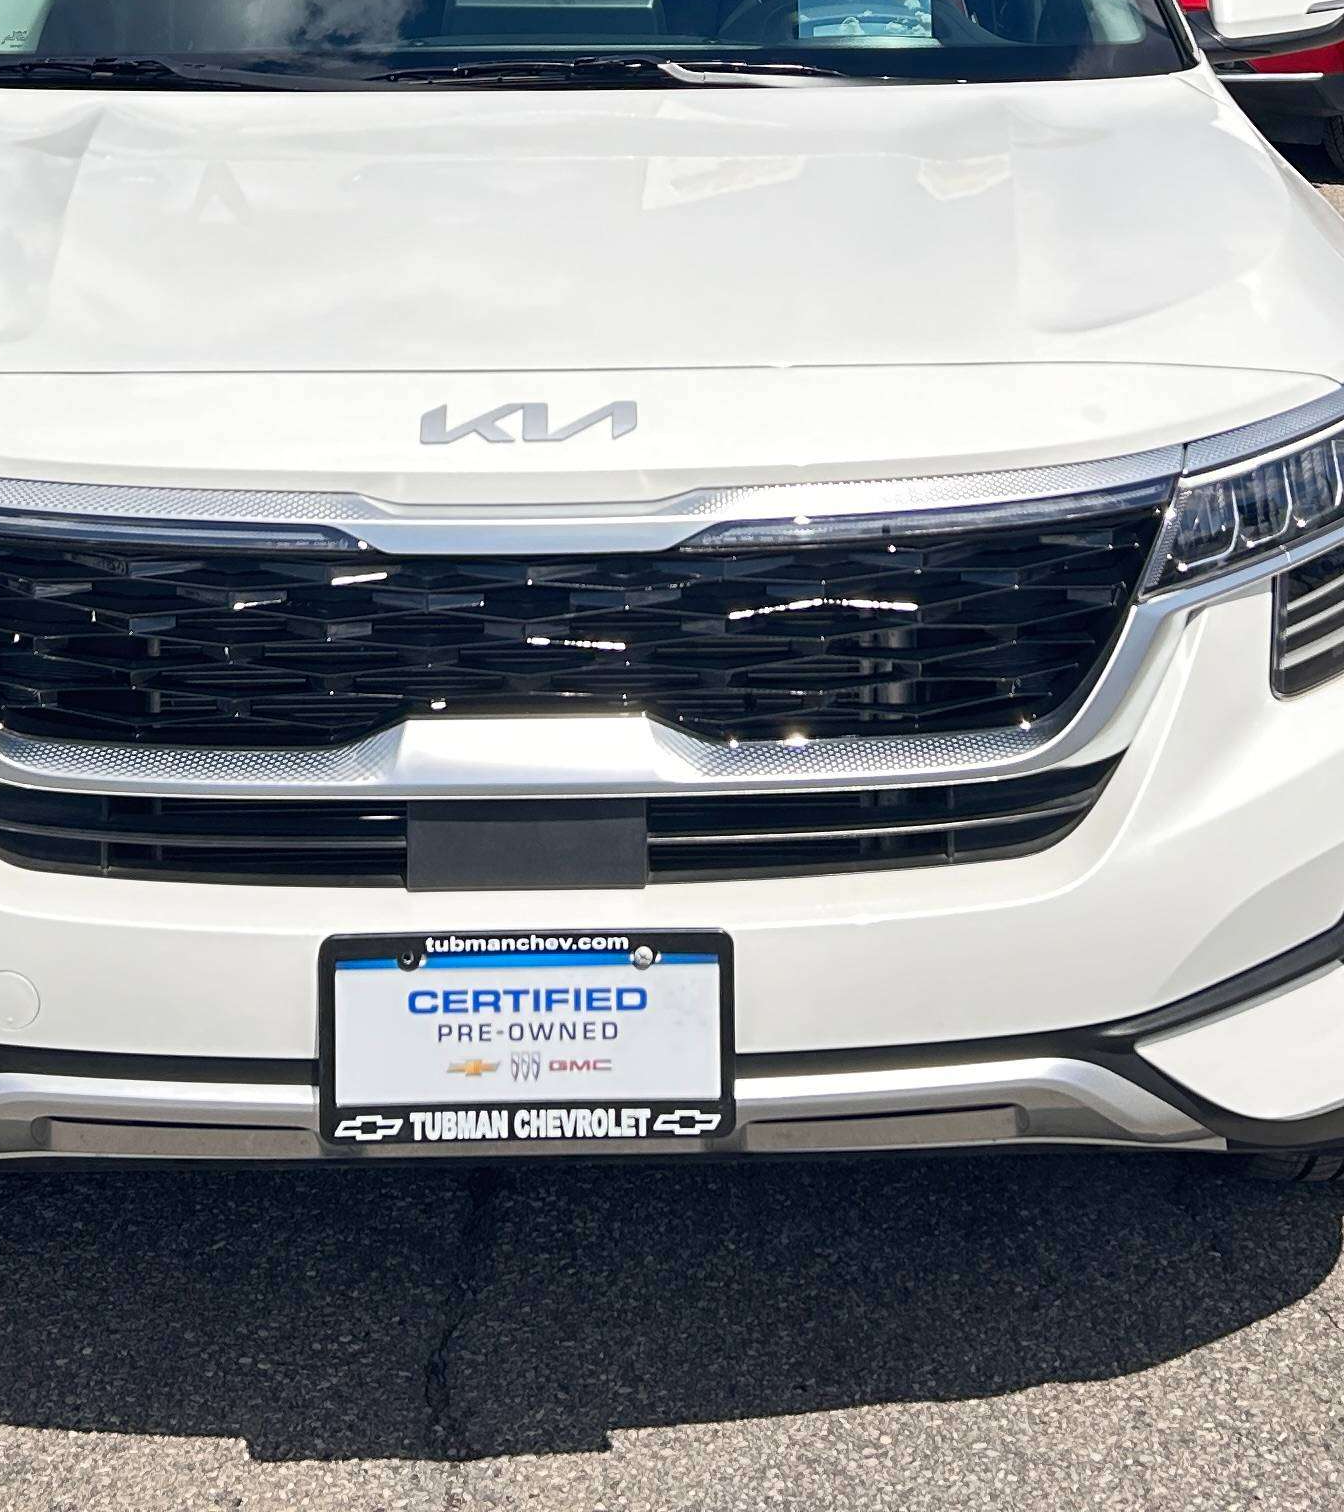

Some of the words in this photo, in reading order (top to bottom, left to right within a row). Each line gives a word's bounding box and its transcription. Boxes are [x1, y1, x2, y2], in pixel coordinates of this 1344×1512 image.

[424, 934, 629, 954] tubmanchev.com
[407, 987, 649, 1014] CERTIFIED
[437, 1021, 619, 1043] PRE-OWNED
[548, 1058, 613, 1072] GMC
[409, 1110, 511, 1142] TUBMAN
[513, 1108, 653, 1139] CHEVROLET
